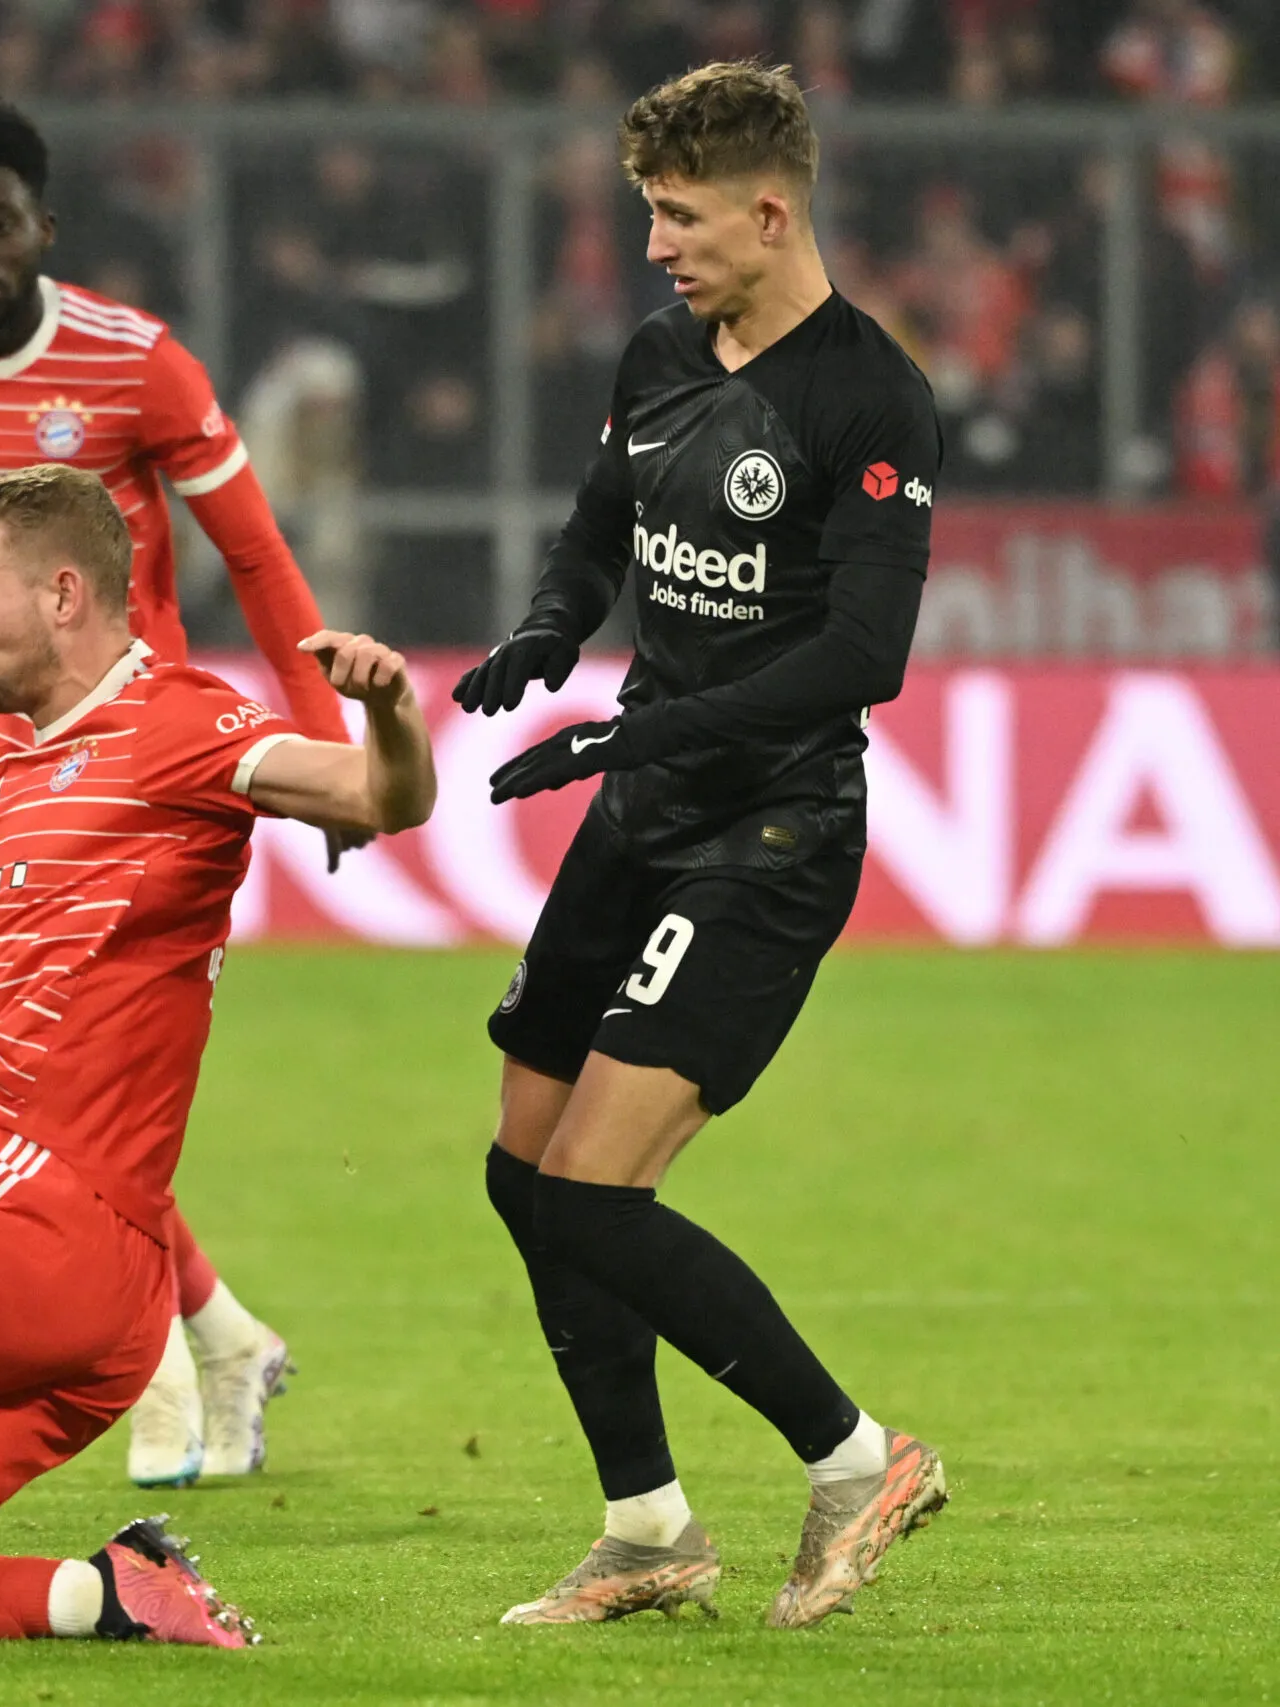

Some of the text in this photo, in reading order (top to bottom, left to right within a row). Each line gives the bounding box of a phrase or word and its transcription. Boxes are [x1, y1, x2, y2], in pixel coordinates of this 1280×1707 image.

[649, 580, 764, 620] Jobs finden
[616, 912, 695, 1006] 9
